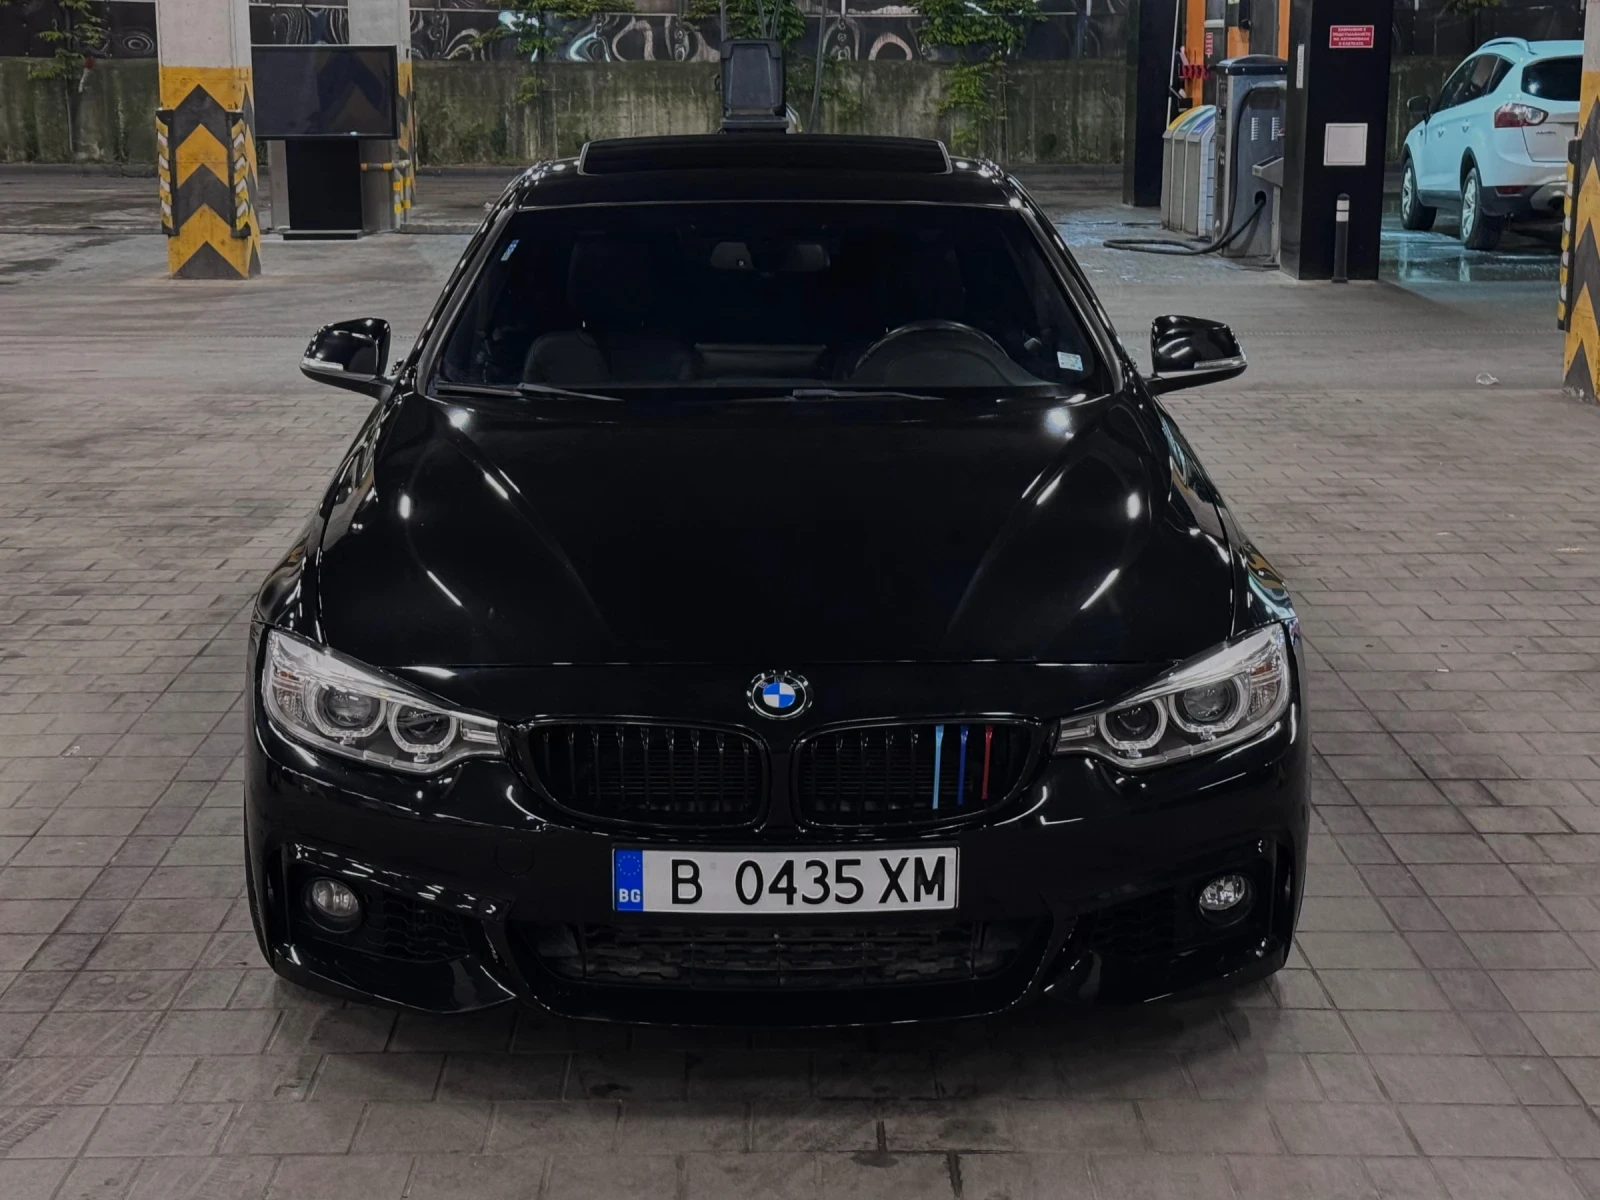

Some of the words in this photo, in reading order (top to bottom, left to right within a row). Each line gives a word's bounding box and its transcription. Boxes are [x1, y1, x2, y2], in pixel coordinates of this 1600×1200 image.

[618, 889, 641, 903] BG
[671, 859, 703, 905] B
[735, 859, 864, 906] 0435
[878, 856, 946, 904] XM
